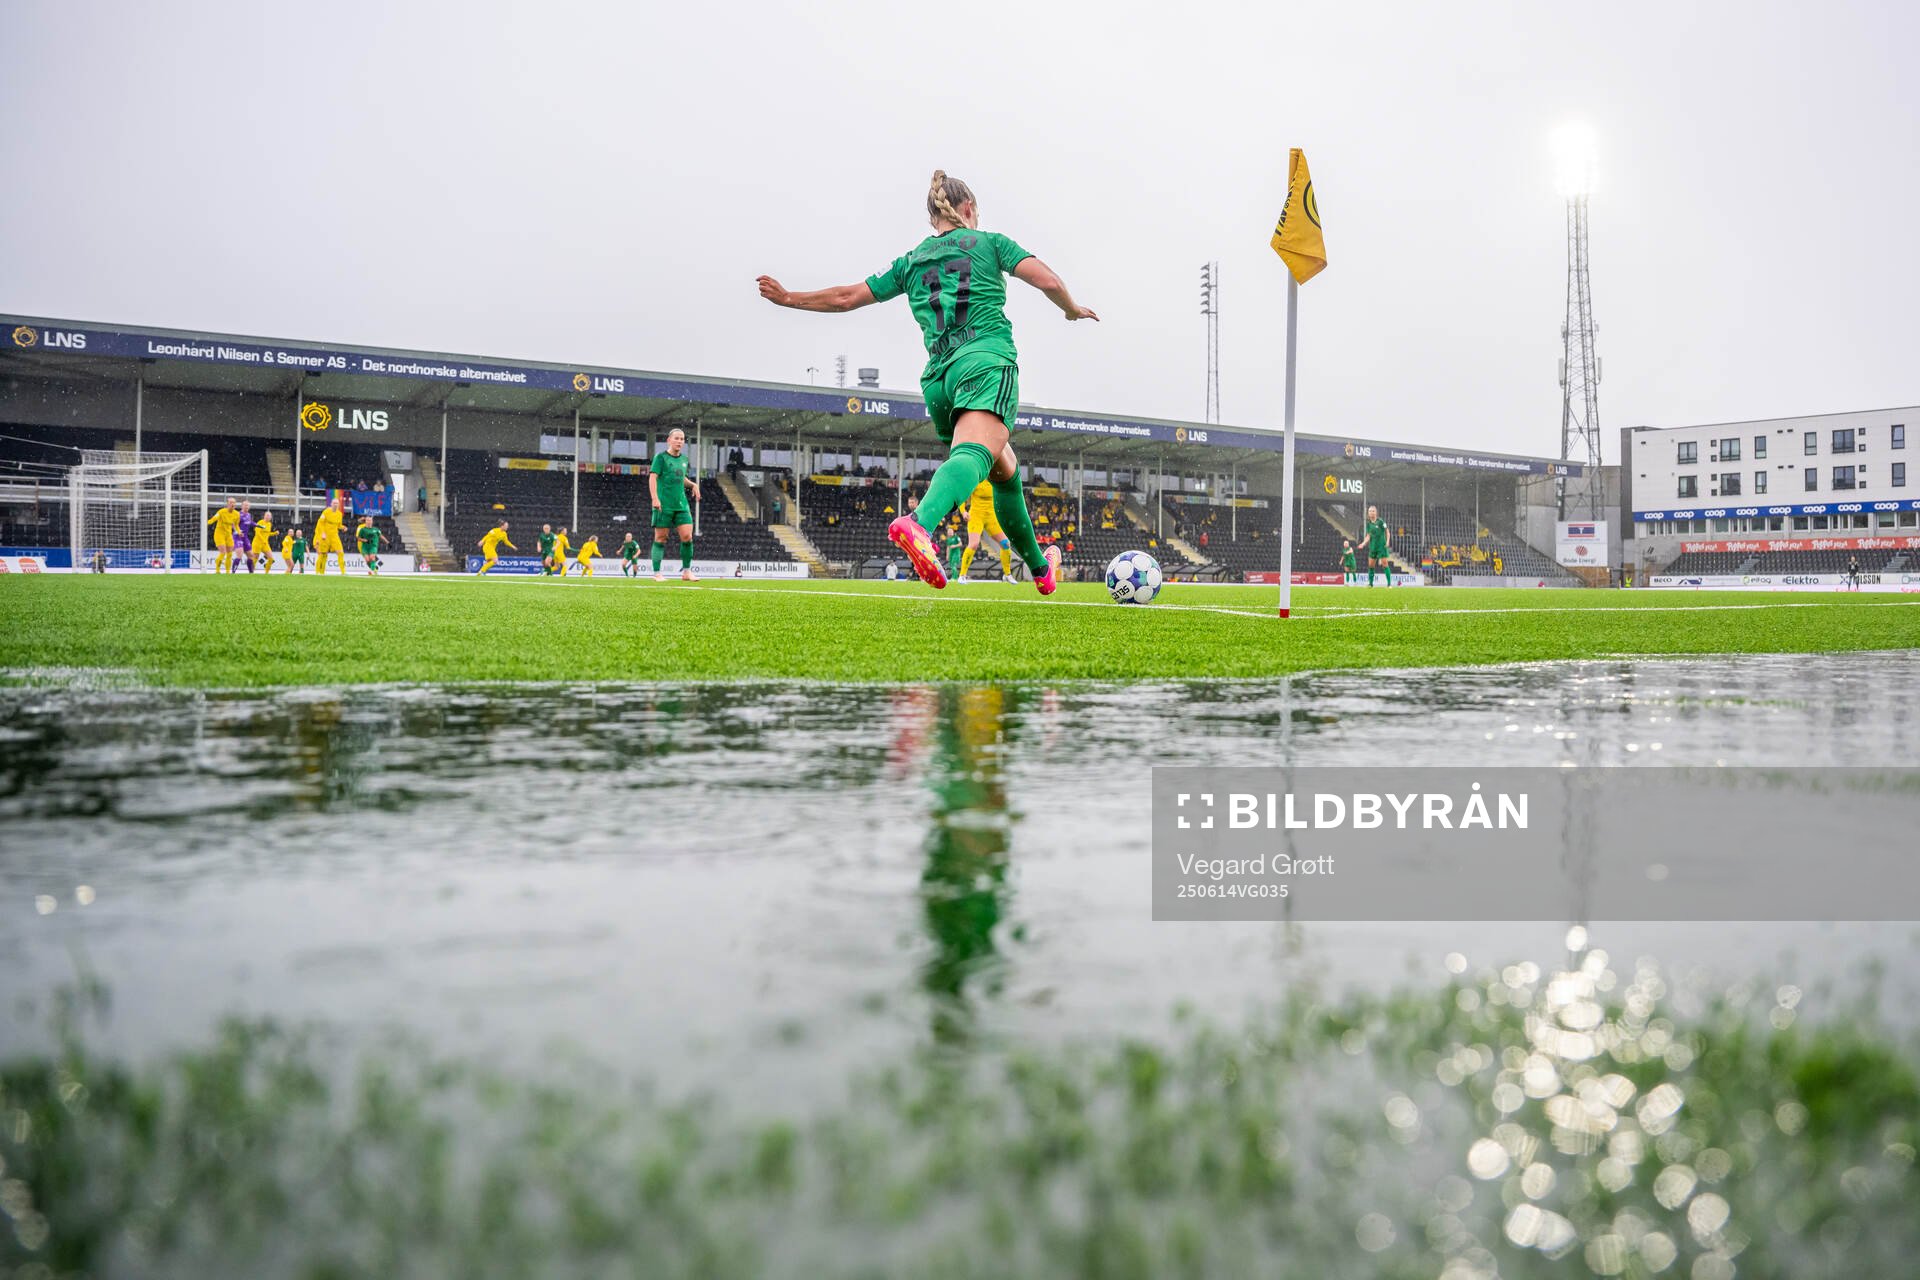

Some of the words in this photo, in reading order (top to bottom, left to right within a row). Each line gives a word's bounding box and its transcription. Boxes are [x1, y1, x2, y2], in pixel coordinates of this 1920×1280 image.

[921, 256, 971, 331] 17
[44, 331, 87, 349] LNS
[148, 341, 214, 358] Leonhard
[218, 347, 260, 363] Nilsen
[263, 351, 274, 363] &
[277, 353, 325, 367] Sønner
[326, 356, 346, 368] AS
[362, 359, 386, 372] Det
[388, 362, 457, 378] nordnorske
[459, 367, 527, 383] alternativet
[594, 377, 625, 393] LNS
[865, 401, 890, 414] LNS
[337, 408, 389, 431] LNS
[1014, 418, 1030, 426] ner
[1030, 417, 1043, 427] AS
[1051, 418, 1067, 429] Det
[1067, 421, 1109, 433] nordnorske
[1110, 424, 1151, 436] alternativet
[1188, 430, 1207, 442] LNS
[1355, 446, 1371, 457] LNS
[1556, 466, 1568, 475] LNS
[1340, 478, 1363, 493] LNS
[1736, 507, 1758, 516] coop
[1769, 506, 1791, 515] coop
[1803, 505, 1826, 514] coop
[1838, 503, 1862, 512] coop
[1874, 502, 1899, 511] coop
[1644, 512, 1664, 520] coop
[1673, 510, 1695, 519] coop
[1704, 509, 1726, 518] coop
[737, 562, 762, 572] Julius
[764, 562, 798, 573] Jakhelln
